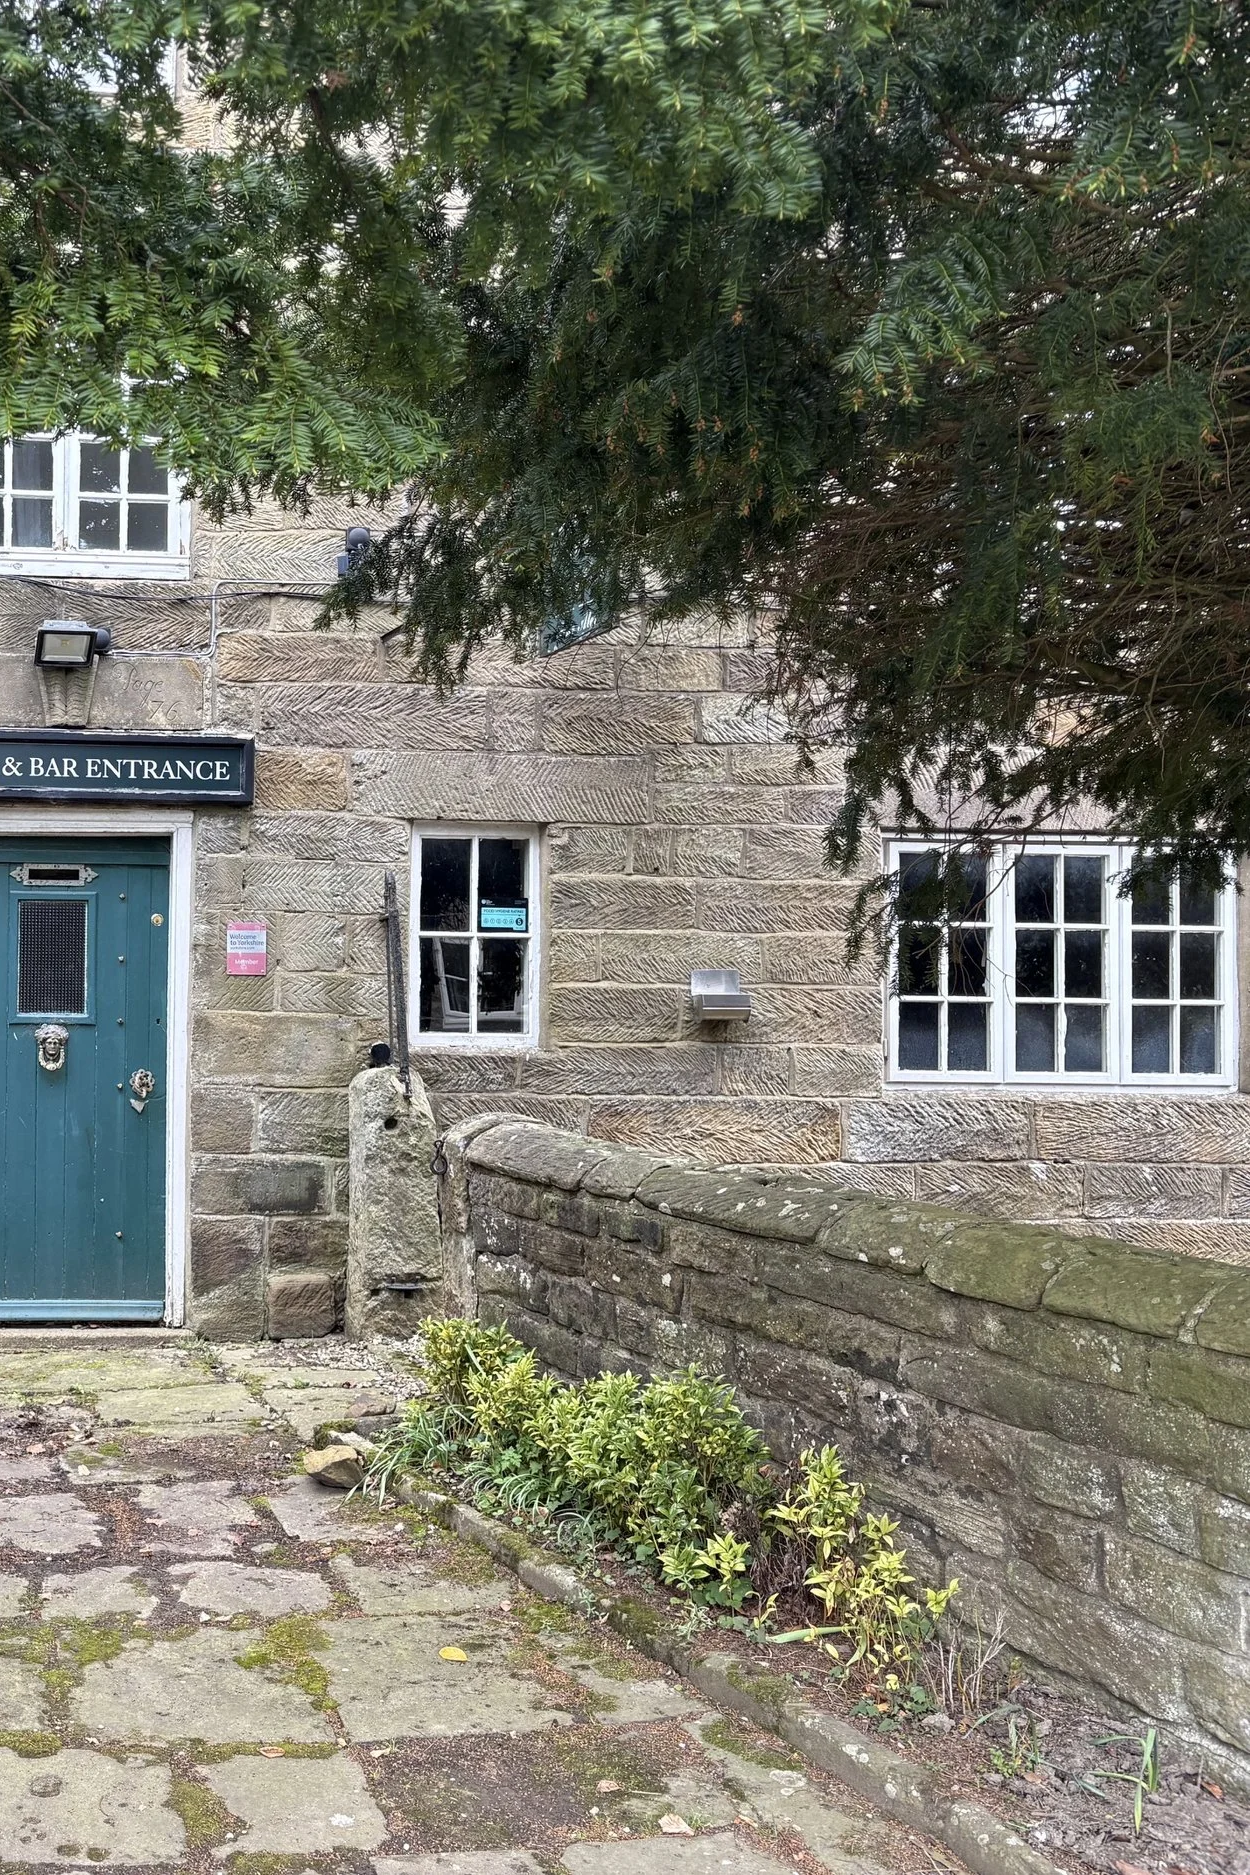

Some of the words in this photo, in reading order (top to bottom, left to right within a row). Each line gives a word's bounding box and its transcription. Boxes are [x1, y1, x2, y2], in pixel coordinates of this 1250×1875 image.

[149, 700, 185, 721] 76
[1, 756, 23, 777] &
[29, 757, 79, 778] BAR
[85, 758, 231, 781] ENTRANCE
